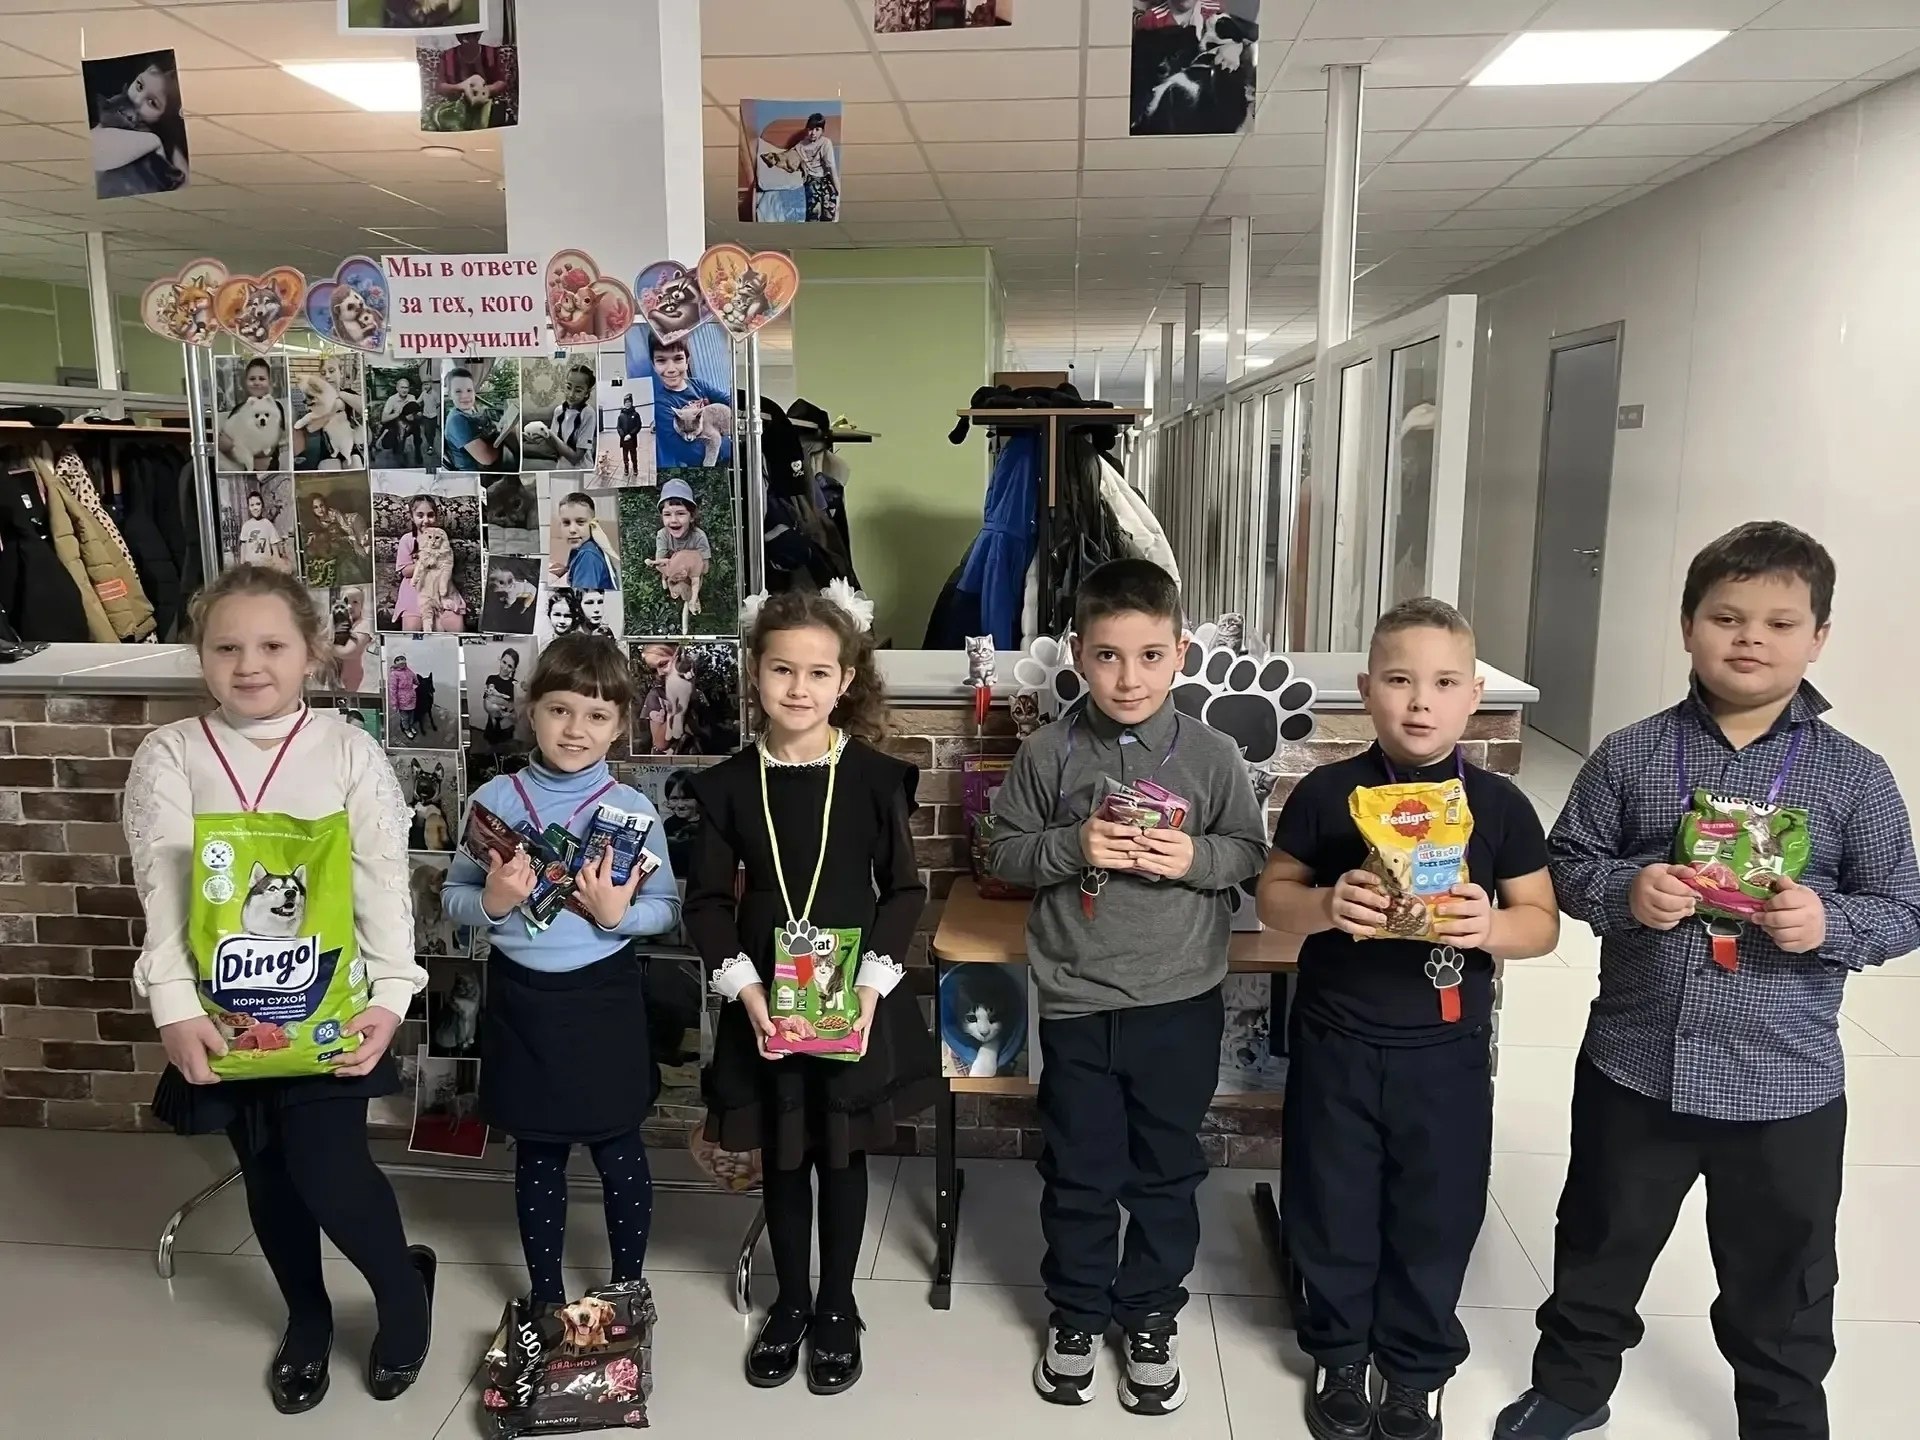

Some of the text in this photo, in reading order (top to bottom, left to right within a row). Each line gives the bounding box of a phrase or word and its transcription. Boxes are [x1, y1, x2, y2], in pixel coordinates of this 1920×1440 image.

[386, 257, 538, 277] Мы в ответе
[399, 295, 533, 318] за тех, кого
[399, 326, 540, 354] приручили!
[1380, 811, 1440, 825] Pedigree
[221, 945, 310, 985] Dingo
[232, 993, 307, 1006] КОРМ СУХОЙ
